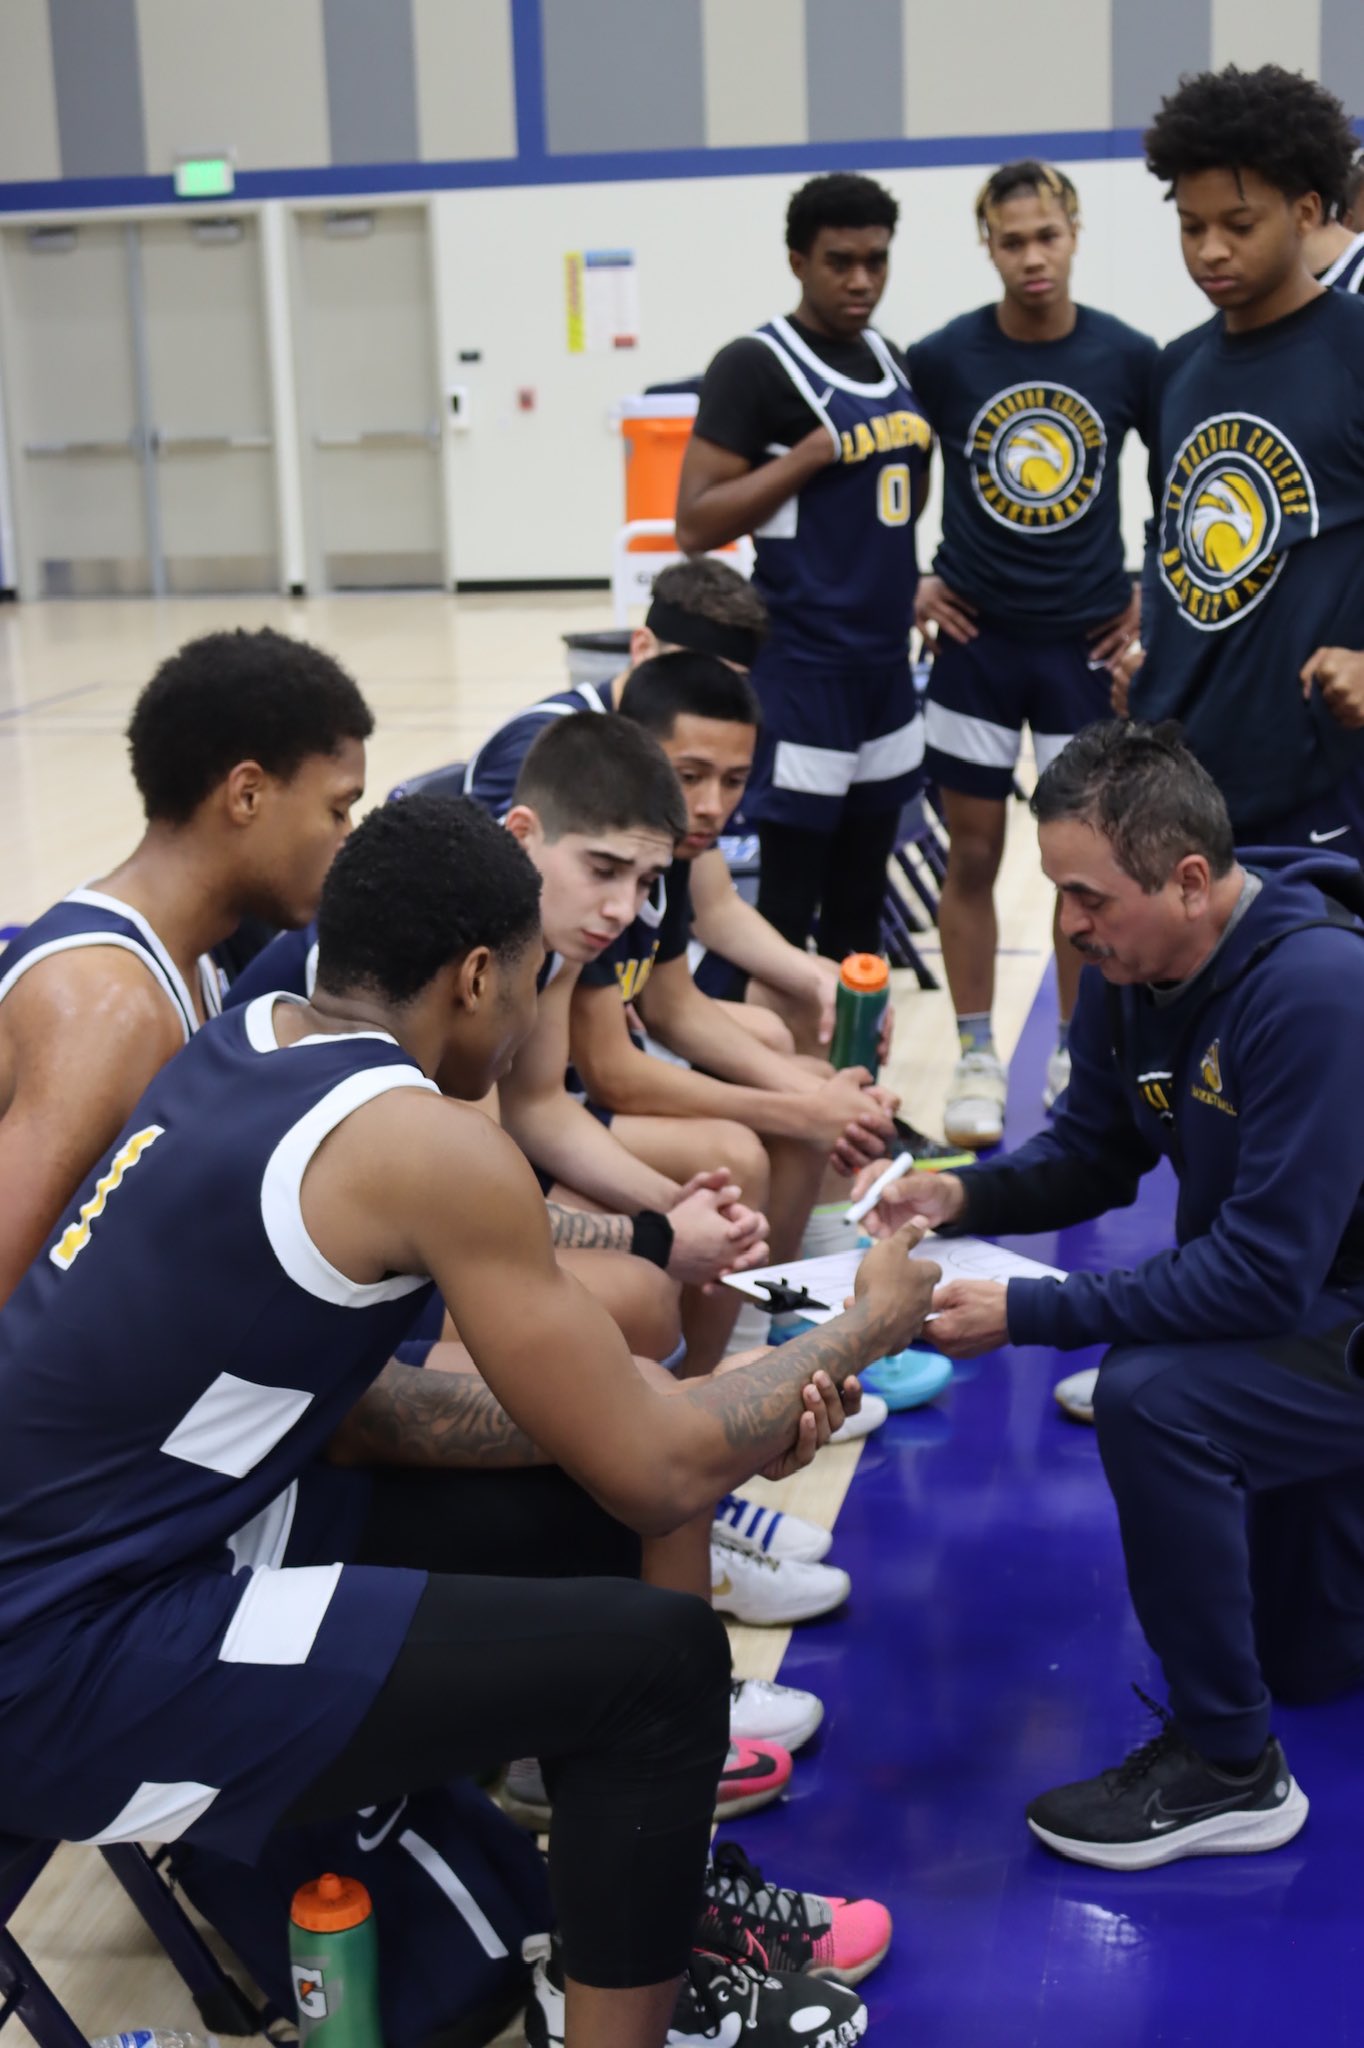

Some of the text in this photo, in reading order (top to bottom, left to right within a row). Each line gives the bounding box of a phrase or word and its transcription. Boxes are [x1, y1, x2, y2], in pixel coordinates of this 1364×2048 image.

[877, 463, 911, 527] 0
[1167, 421, 1310, 516] LA HARBOR COLLEGE
[291, 1964, 328, 2019] G
